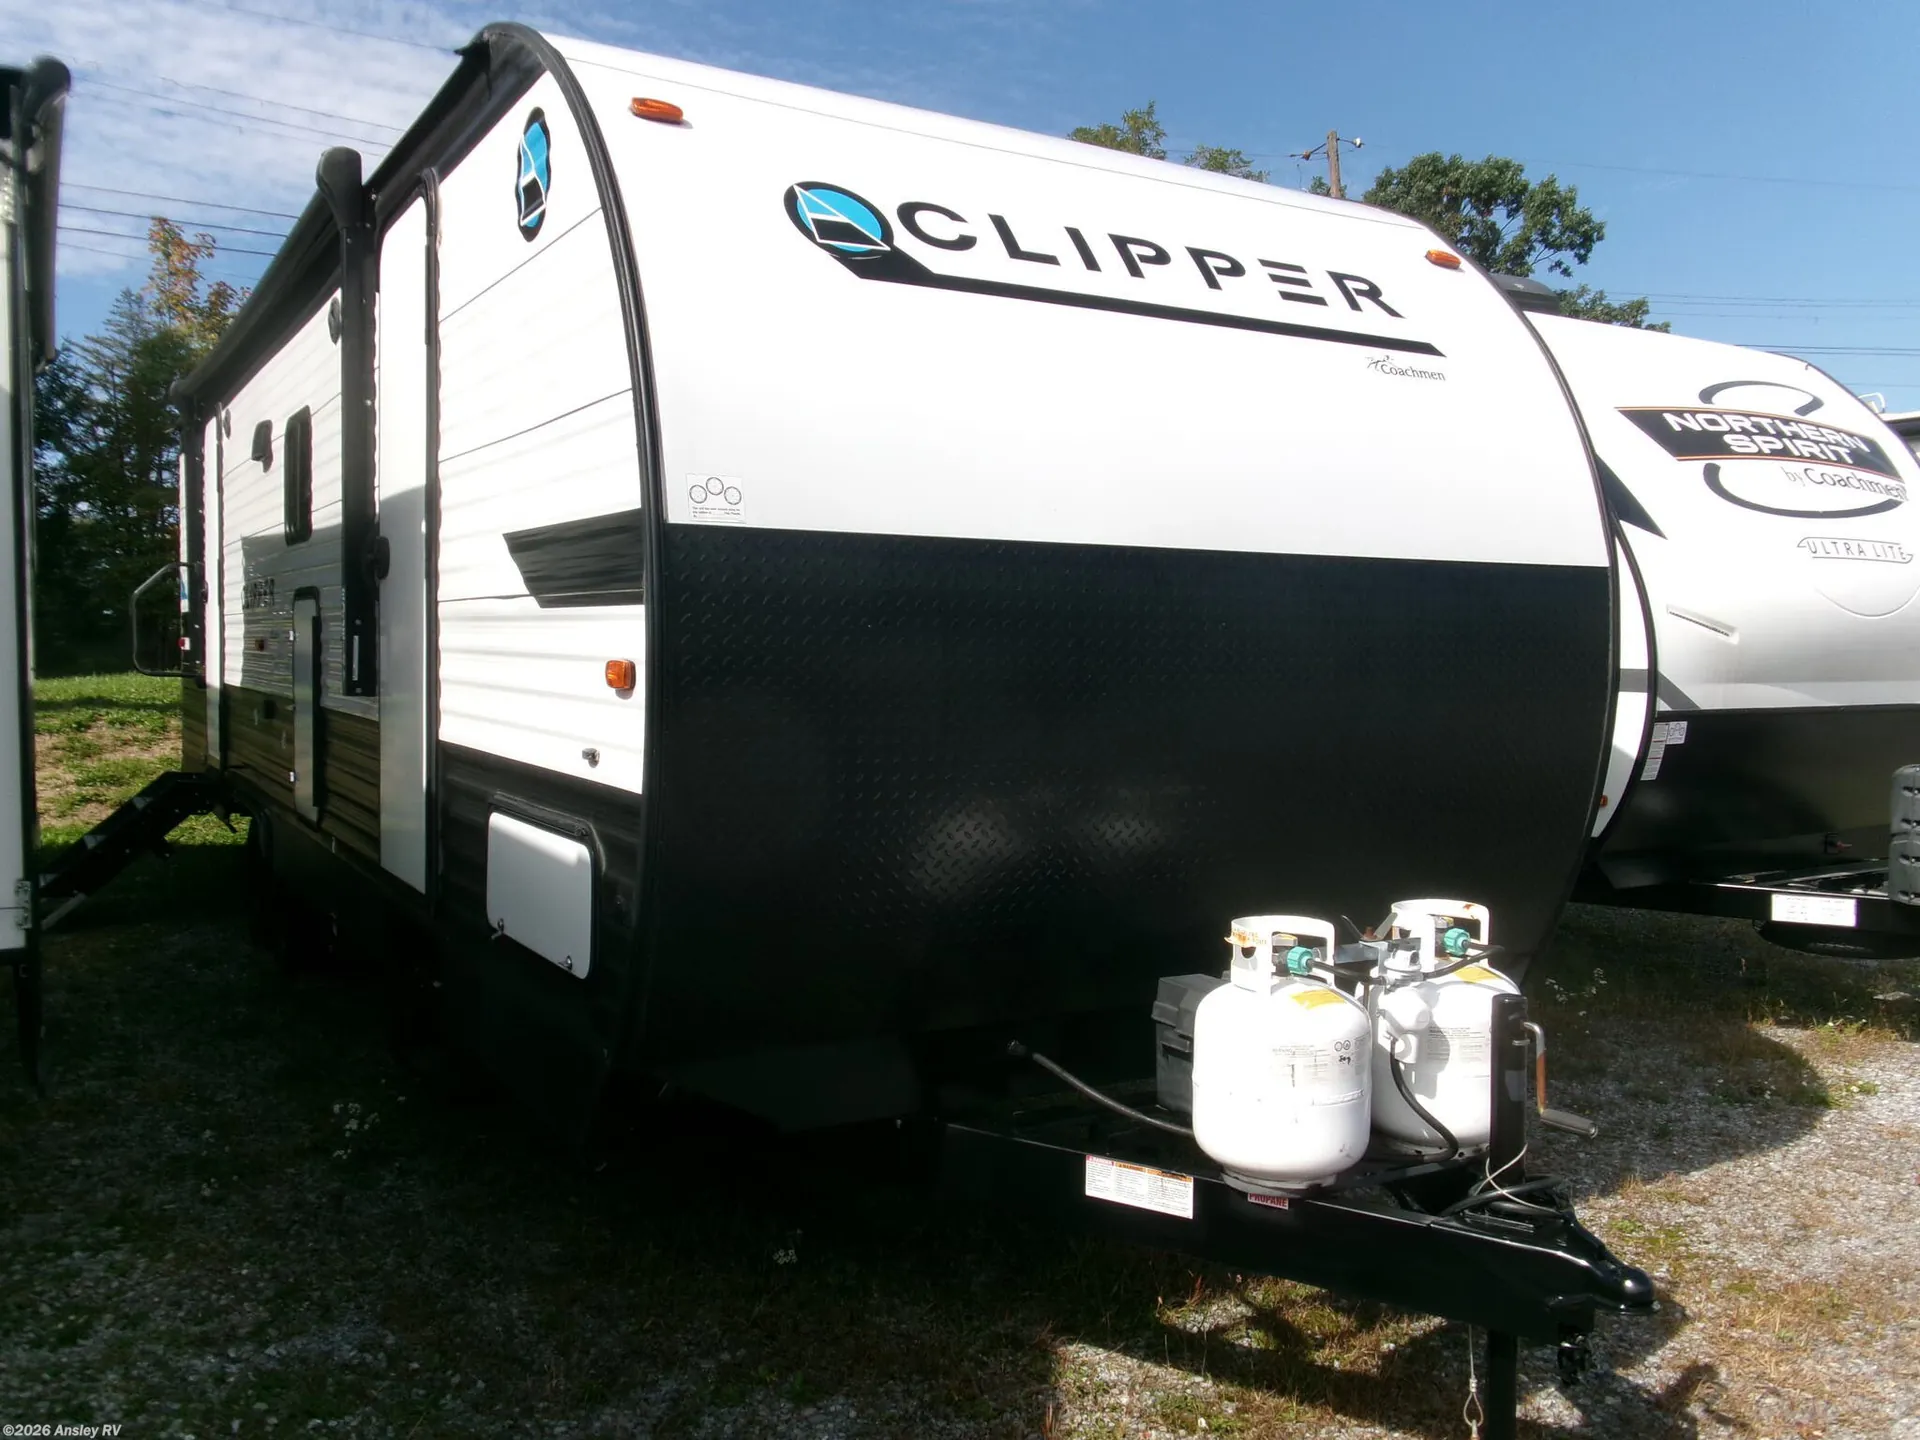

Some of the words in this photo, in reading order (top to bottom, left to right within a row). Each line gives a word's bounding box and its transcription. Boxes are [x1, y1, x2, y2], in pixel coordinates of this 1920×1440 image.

[896, 201, 1406, 319] CLIPPER
[1380, 363, 1446, 381] Coachmen
[1661, 412, 1871, 453] NORTHERN
[1722, 433, 1854, 464] SPIRIT
[1781, 466, 1804, 487] by
[1803, 467, 1909, 501] Coachmen
[1807, 540, 1867, 557] ULTRA
[1872, 543, 1907, 561] LITE
